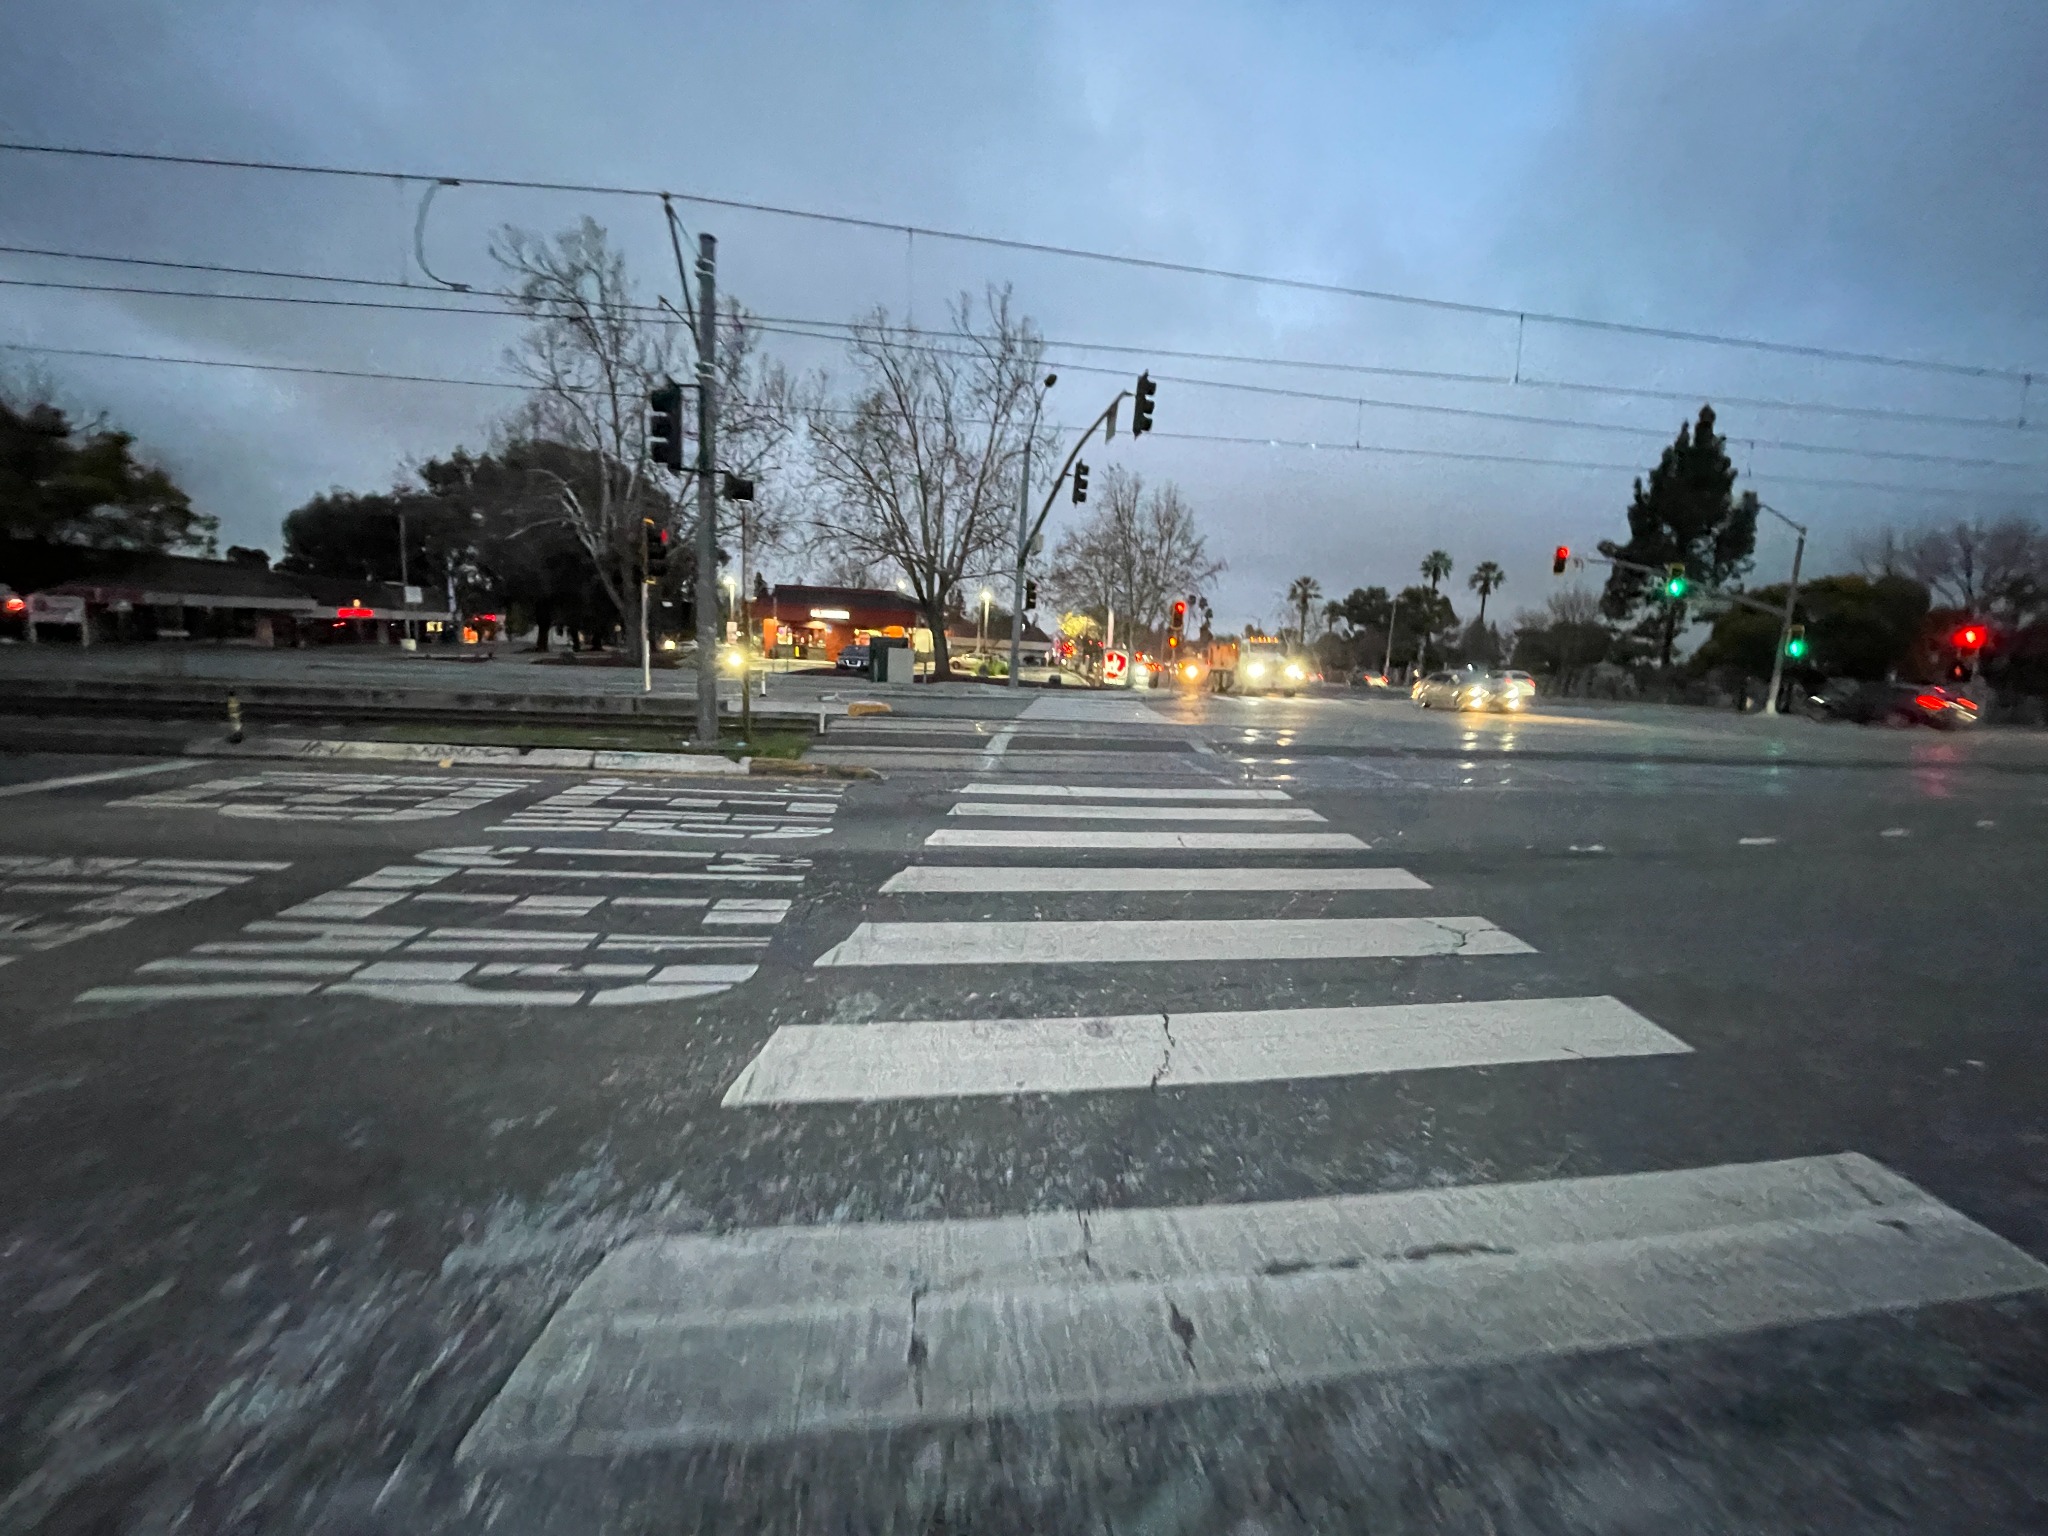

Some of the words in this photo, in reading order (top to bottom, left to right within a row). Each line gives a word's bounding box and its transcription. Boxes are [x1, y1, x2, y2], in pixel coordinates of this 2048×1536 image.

[105, 772, 542, 820] KEEP
[484, 778, 844, 838] CLEAR
[75, 845, 813, 1007] CLEAR
